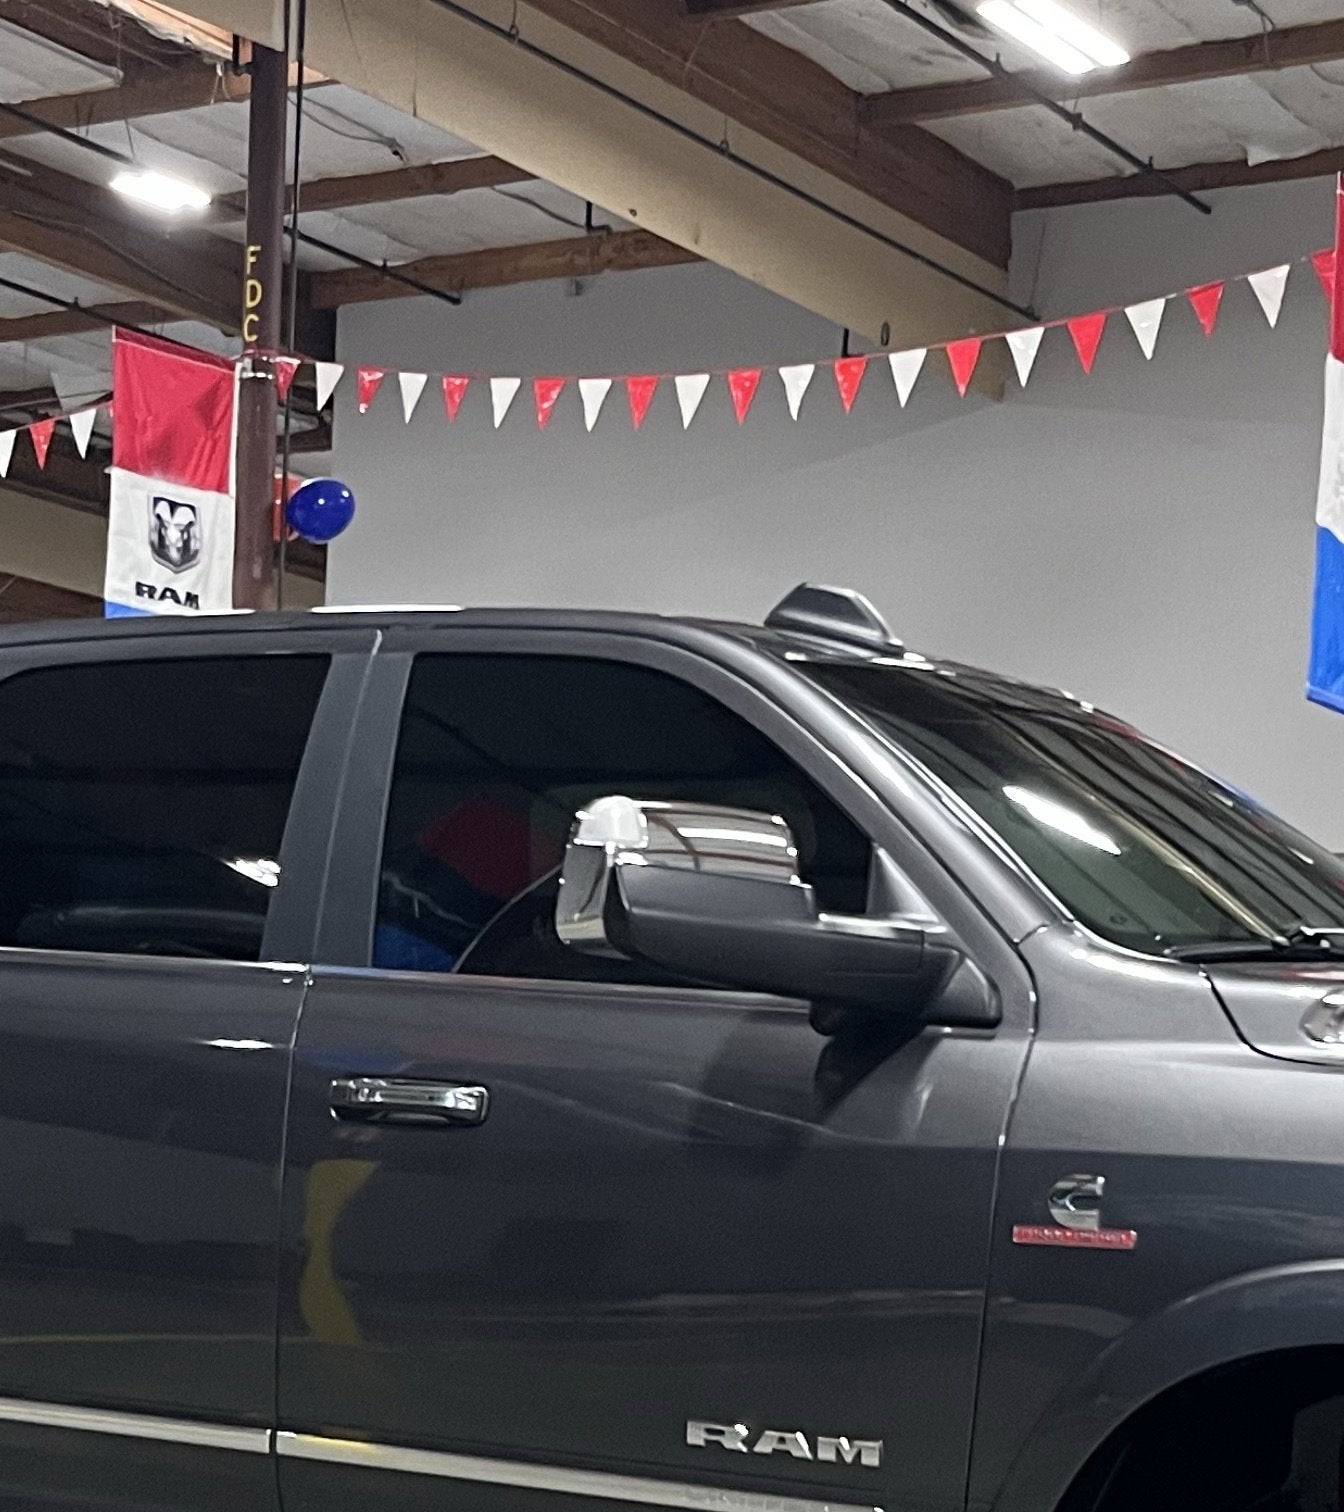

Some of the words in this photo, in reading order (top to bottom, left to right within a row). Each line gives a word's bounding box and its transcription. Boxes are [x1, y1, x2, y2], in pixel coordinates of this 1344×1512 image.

[243, 245, 262, 342] FDC
[135, 581, 200, 610] RAM
[686, 1420, 883, 1468] RAM
